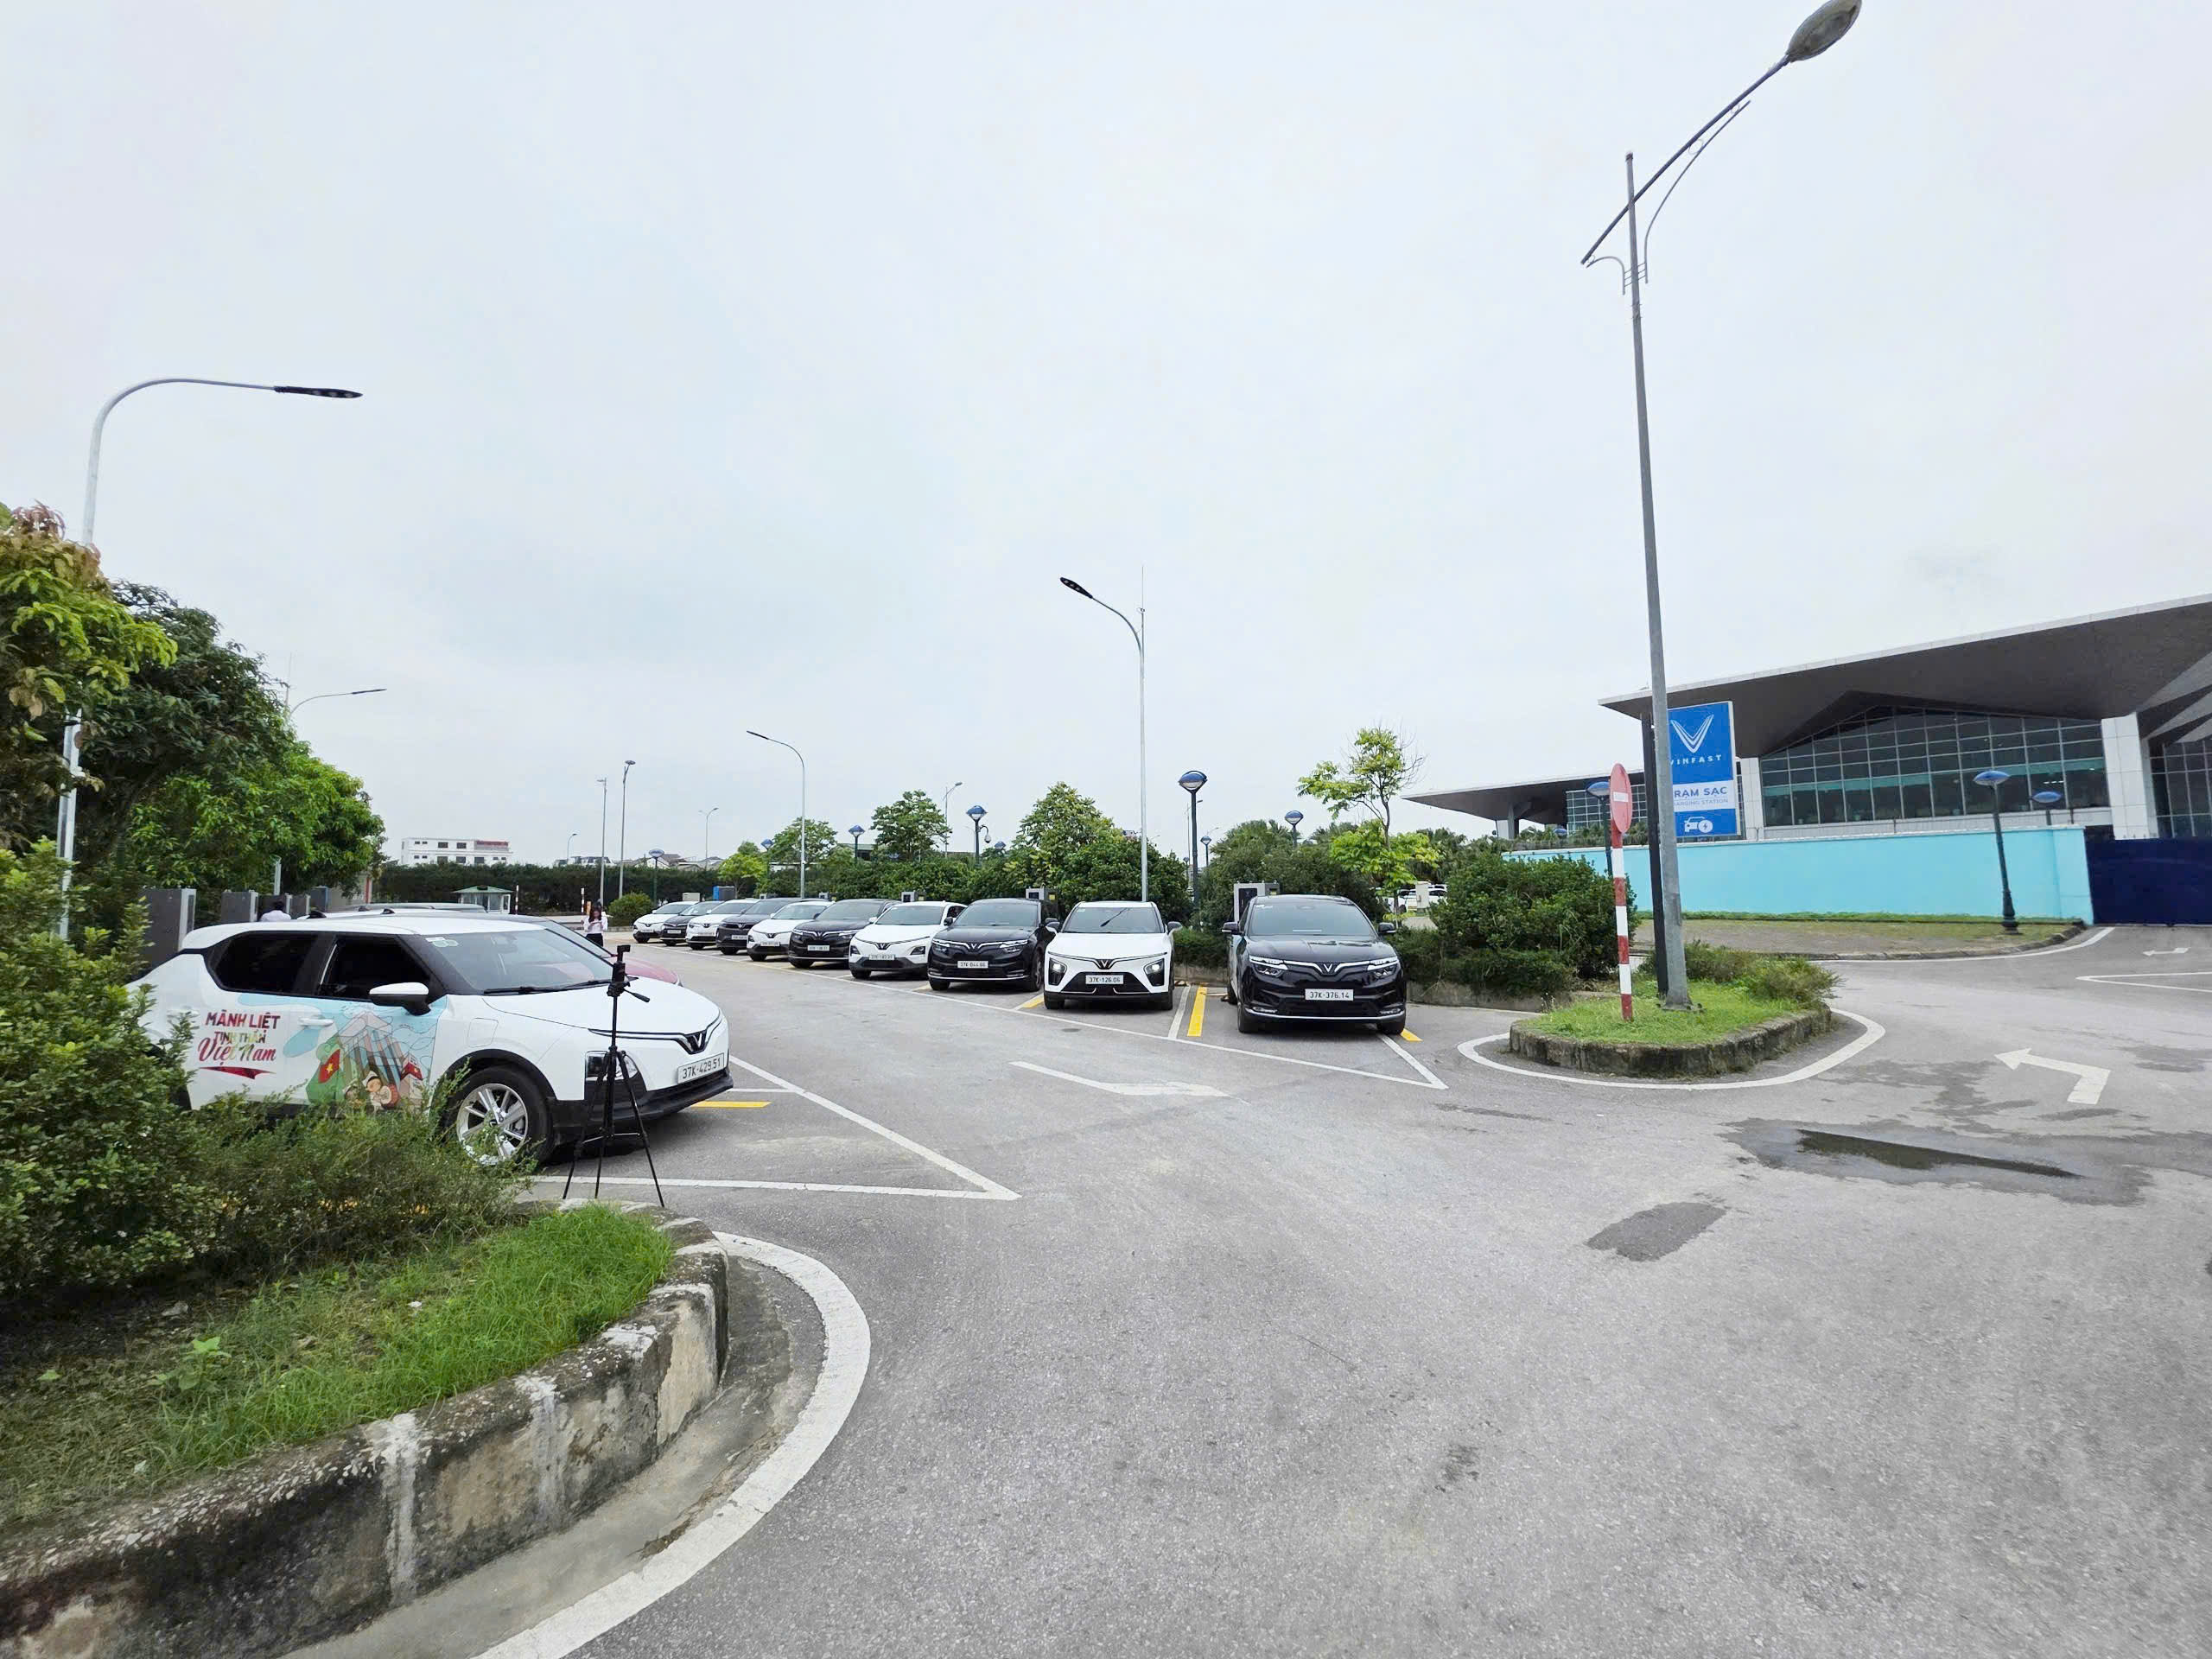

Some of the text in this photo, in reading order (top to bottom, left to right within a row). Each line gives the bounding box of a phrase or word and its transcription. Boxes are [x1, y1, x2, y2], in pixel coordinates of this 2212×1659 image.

[1674, 786, 1727, 799] RẠM SẠC
[238, 1043, 276, 1061] Nam
